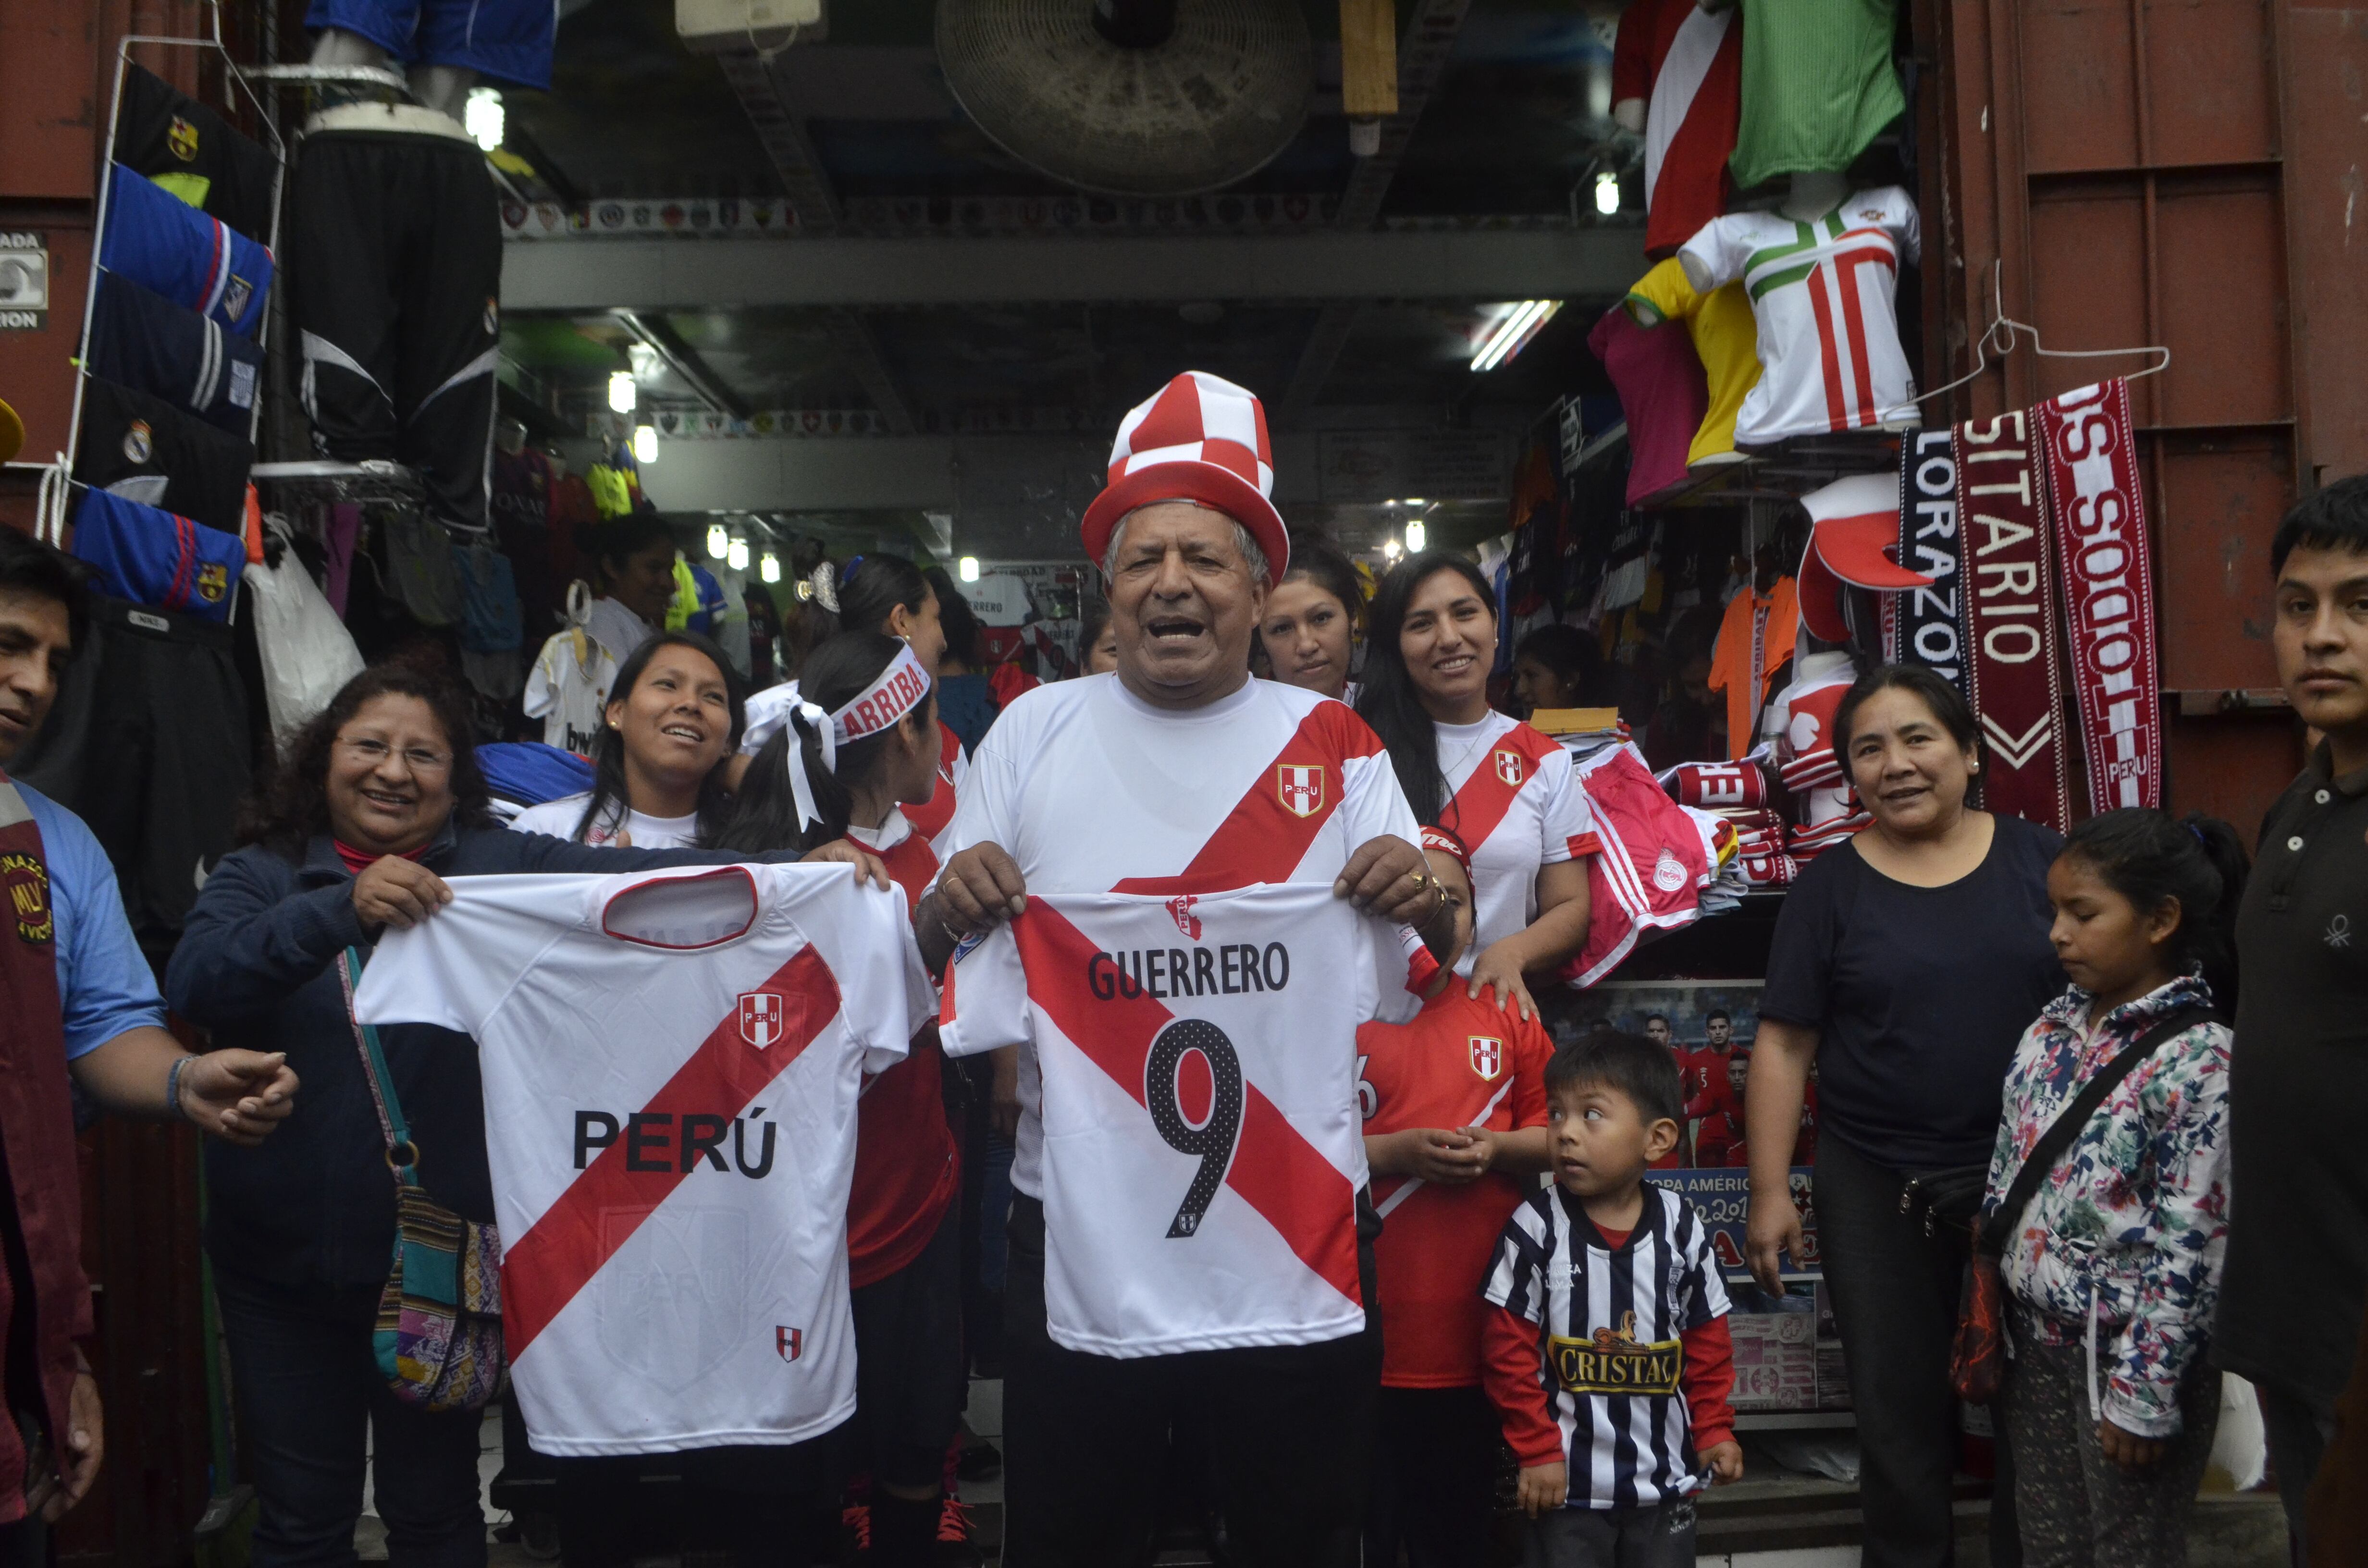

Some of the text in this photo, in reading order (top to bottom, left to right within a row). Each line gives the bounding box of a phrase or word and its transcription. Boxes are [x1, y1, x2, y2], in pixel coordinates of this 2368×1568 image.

[0, 311, 37, 328] ION
[843, 663, 925, 736] ARRIBA
[1500, 760, 1519, 771] PERU
[2109, 755, 2148, 784] PERU
[1285, 784, 1318, 796] PERU
[1178, 899, 1188, 930] PERU
[1088, 941, 1290, 1001] GUERRERO
[745, 1012, 777, 1024] PERU
[1474, 1048, 1498, 1059] PERU
[1701, 1074, 1707, 1088] 5
[1144, 1018, 1247, 1239] 9
[573, 1107, 777, 1180] PERÚ
[1688, 1175, 1749, 1191] AMÉRIC
[1560, 1348, 1671, 1384] CRISTAL
